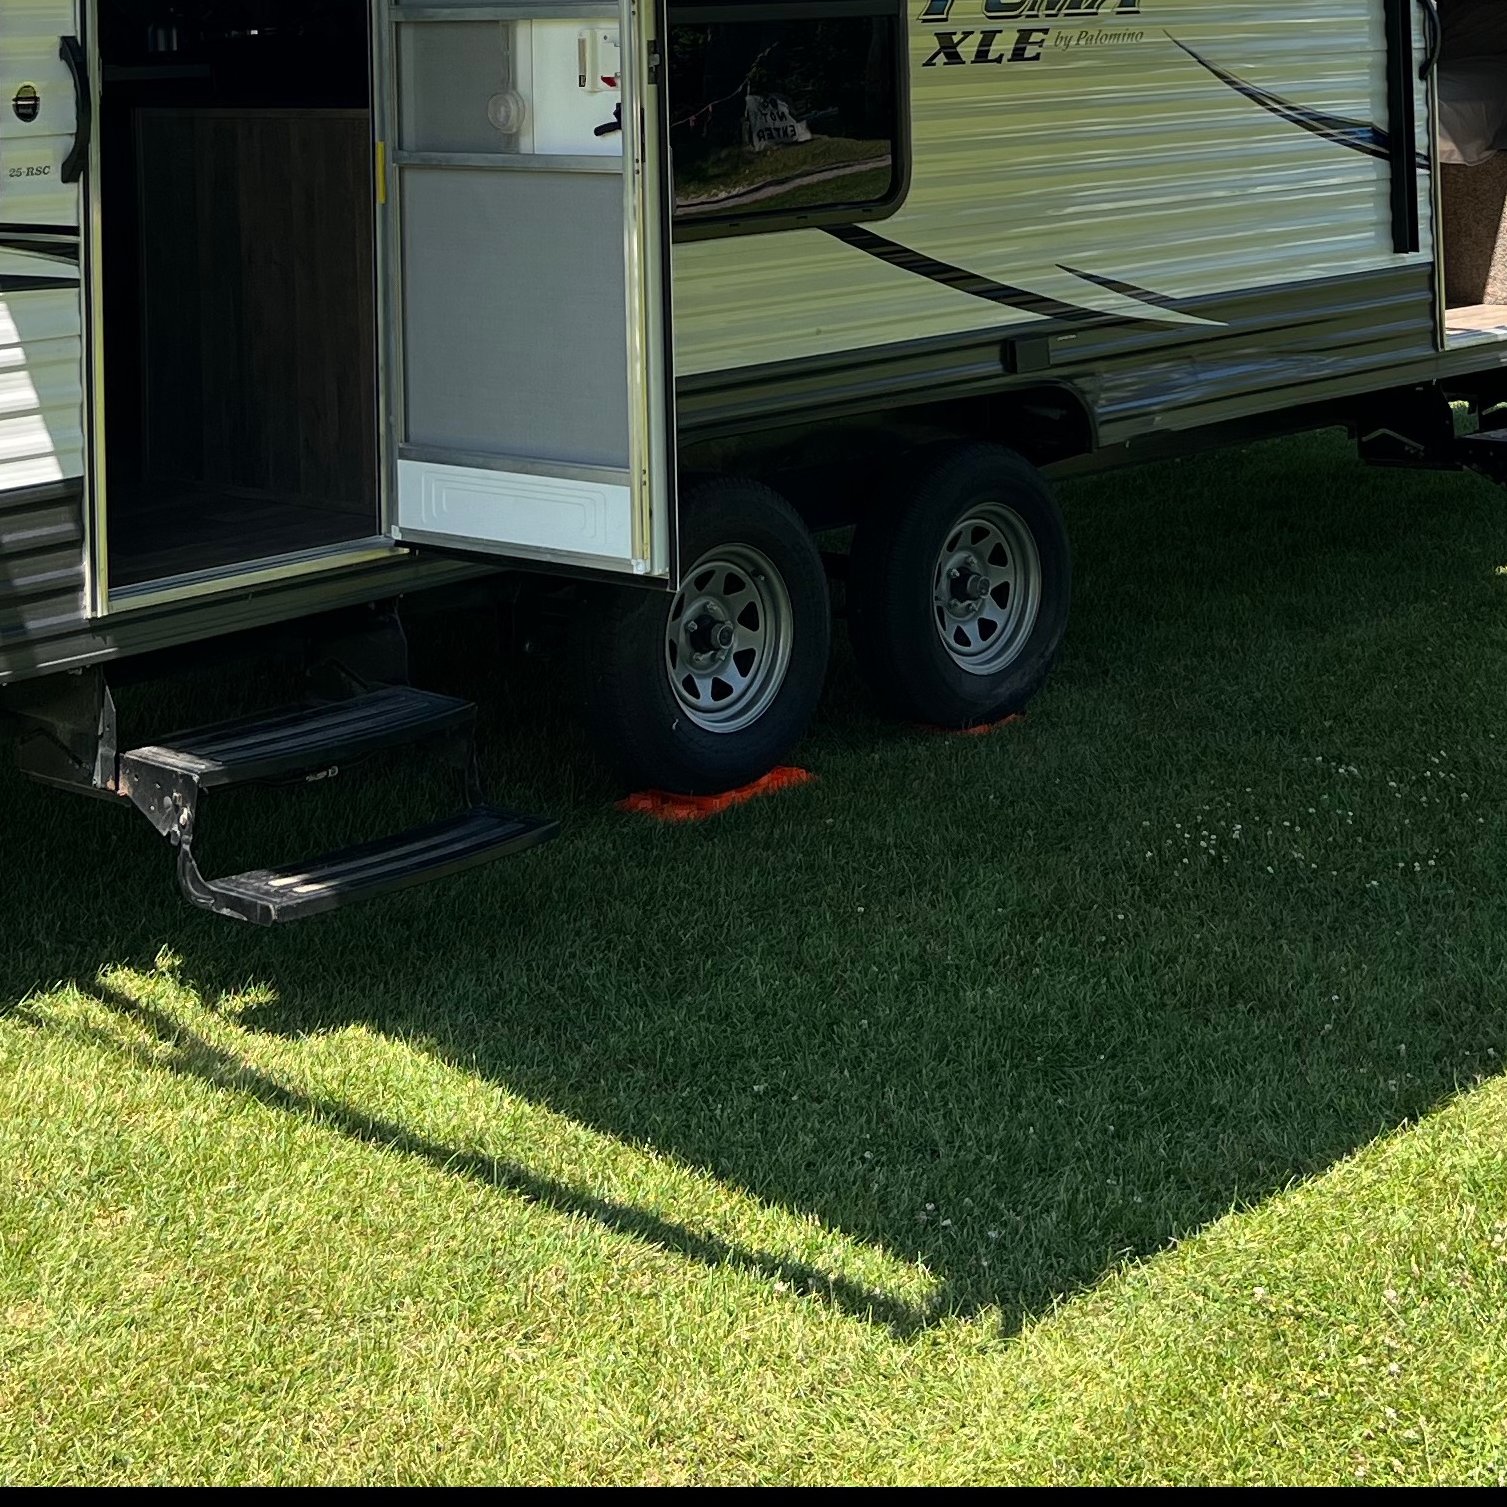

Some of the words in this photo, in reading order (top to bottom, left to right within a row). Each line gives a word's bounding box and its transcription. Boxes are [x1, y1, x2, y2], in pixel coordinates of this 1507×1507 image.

[921, 27, 1051, 68] XLE
[1054, 30, 1074, 52] by
[1075, 27, 1145, 47] Palomino
